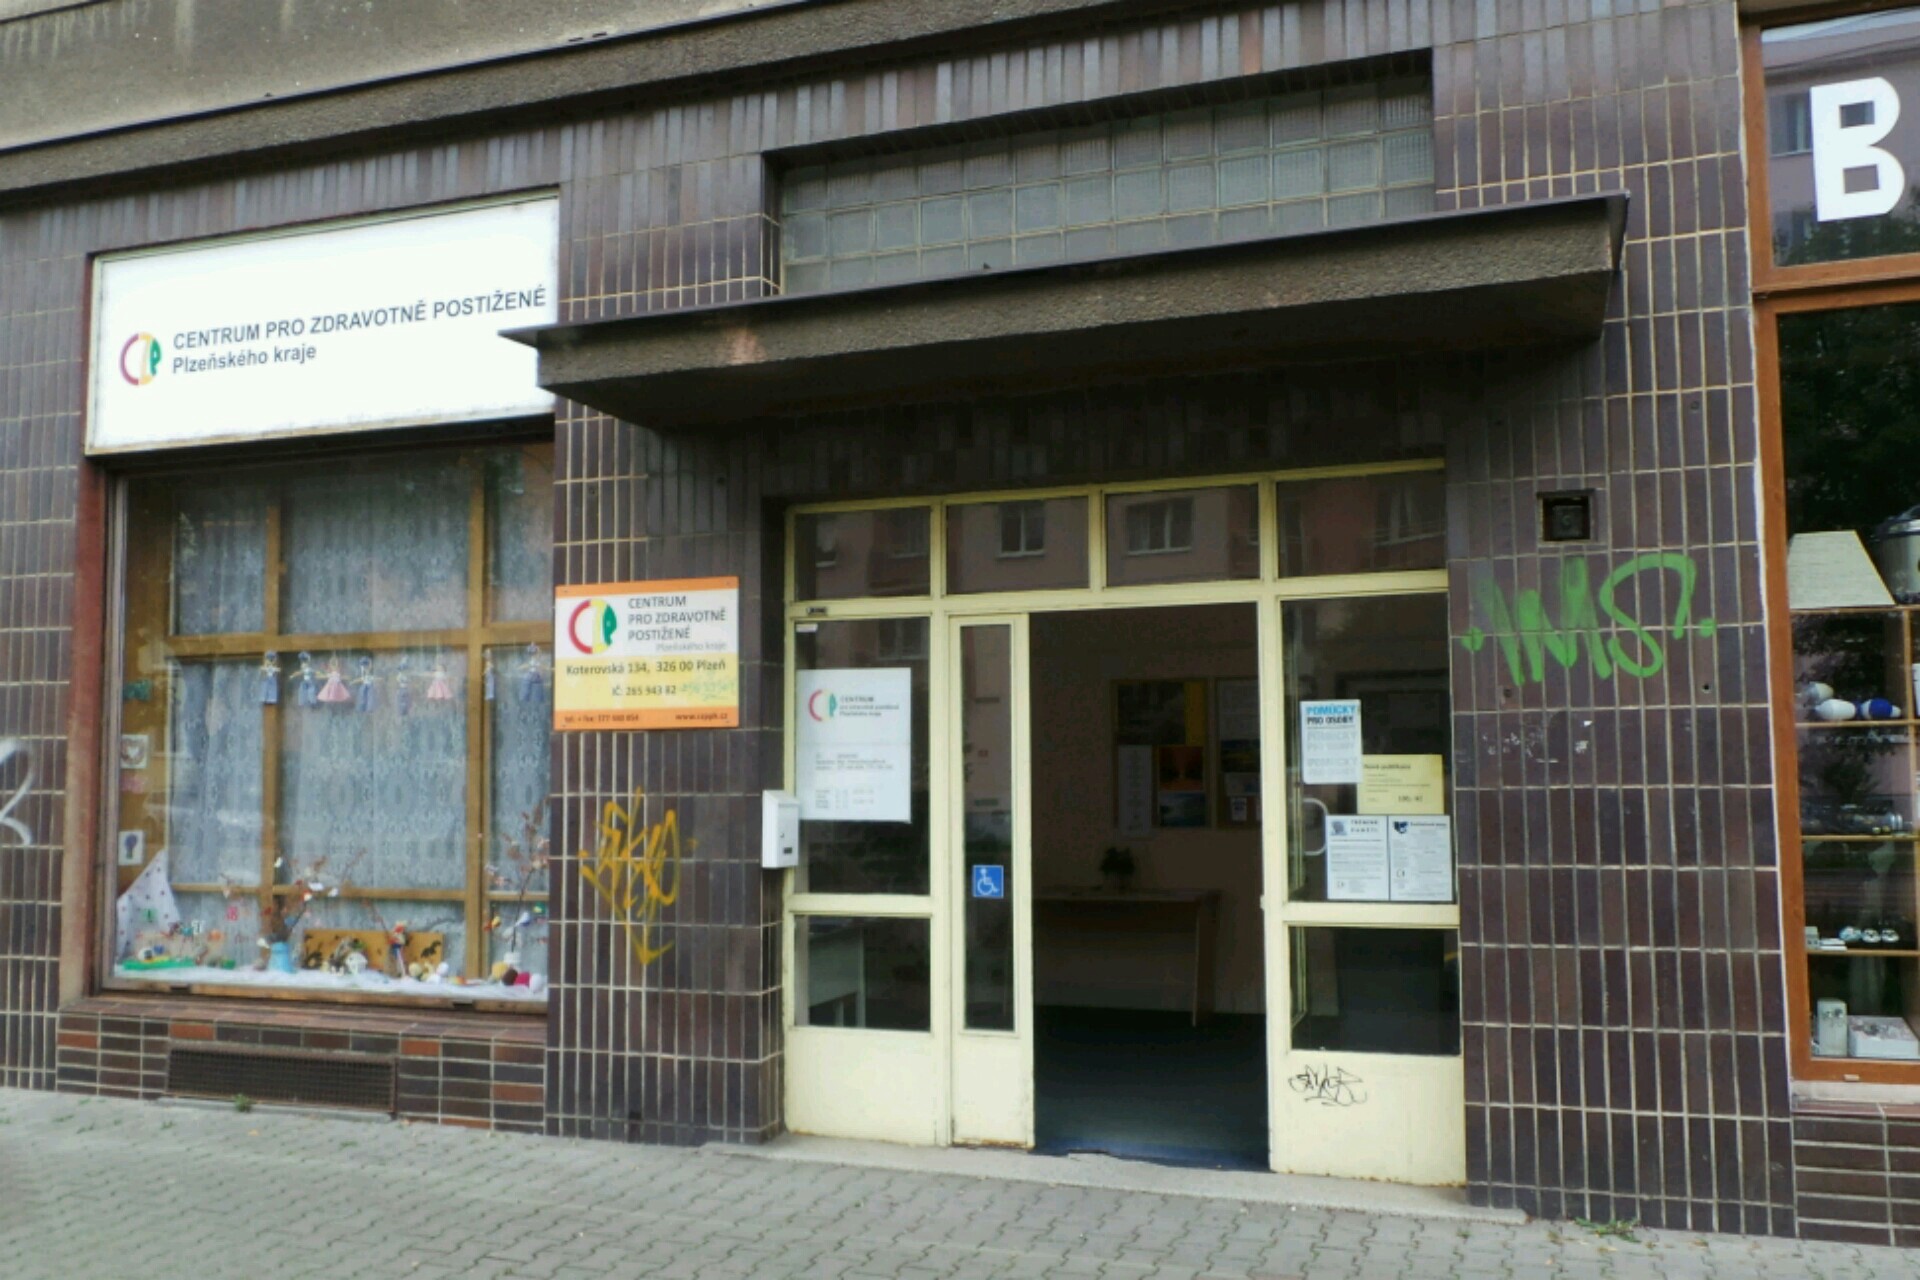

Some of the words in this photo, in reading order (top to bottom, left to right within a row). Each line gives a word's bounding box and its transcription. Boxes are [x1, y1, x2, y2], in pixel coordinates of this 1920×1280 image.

[1810, 76, 1905, 222] B
[173, 323, 260, 350] CENTRUM
[266, 318, 305, 339] PRO
[310, 299, 426, 334] ZDRAVOTNĚ
[433, 284, 546, 319] POSTIŽENÉ
[172, 349, 268, 374] Plzeňského
[274, 344, 317, 365] kraje
[628, 596, 687, 609] CENTRUM
[628, 614, 653, 625] PRO
[628, 625, 690, 641] POSTIŽENÉ
[628, 662, 650, 674] 134,
[656, 661, 677, 673] 326
[679, 661, 694, 672] 00
[696, 660, 726, 671] Plzeň
